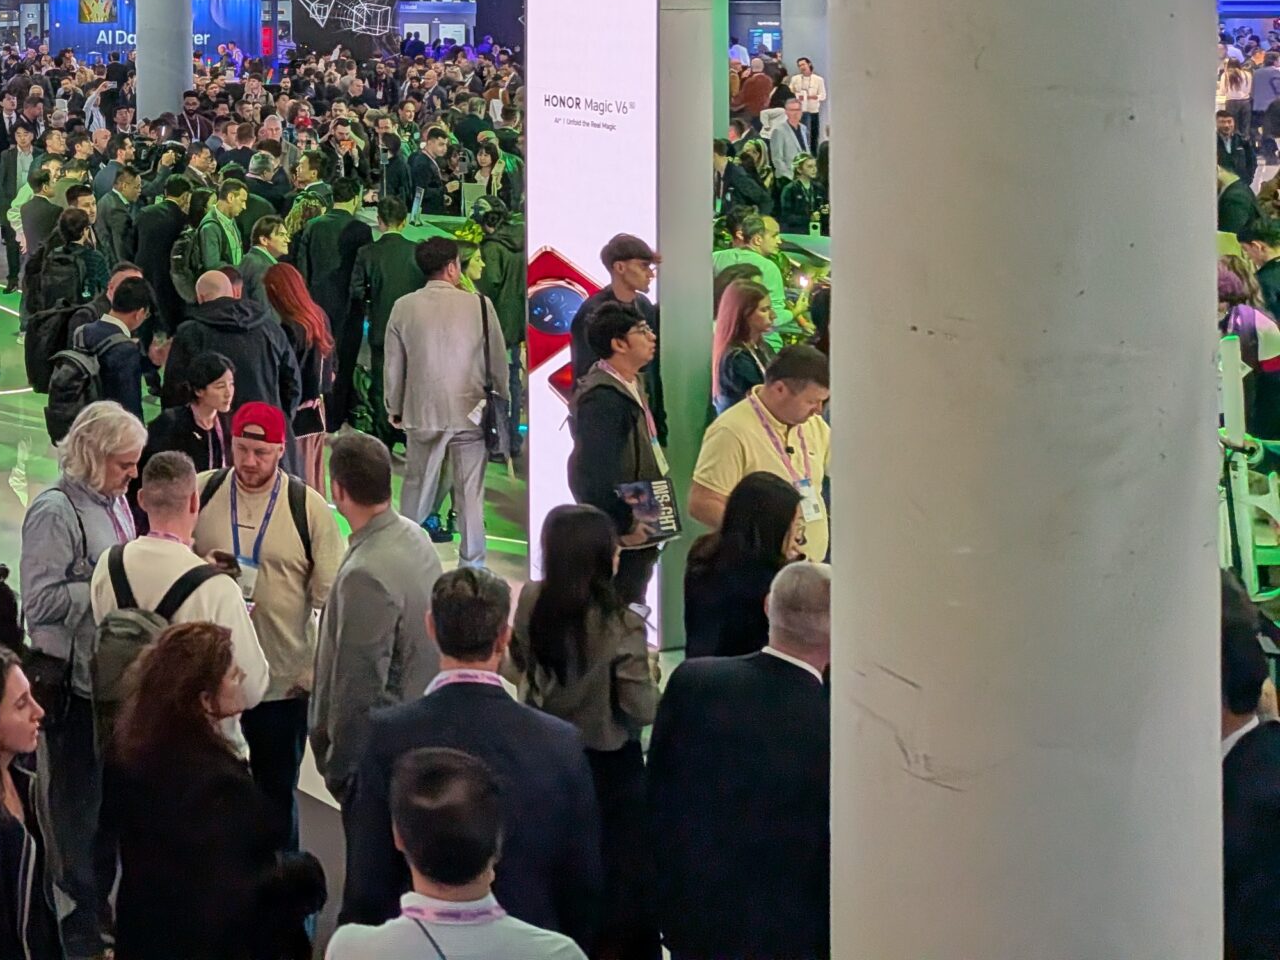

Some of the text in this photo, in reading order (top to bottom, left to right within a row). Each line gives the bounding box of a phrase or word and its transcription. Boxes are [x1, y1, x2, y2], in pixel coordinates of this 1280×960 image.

[96, 30, 136, 45] AI Da
[543, 94, 581, 110] HONOR
[584, 98, 613, 115] Magic
[615, 99, 628, 115] V6
[601, 122, 617, 132] Magic
[651, 480, 677, 532] INSGHT
